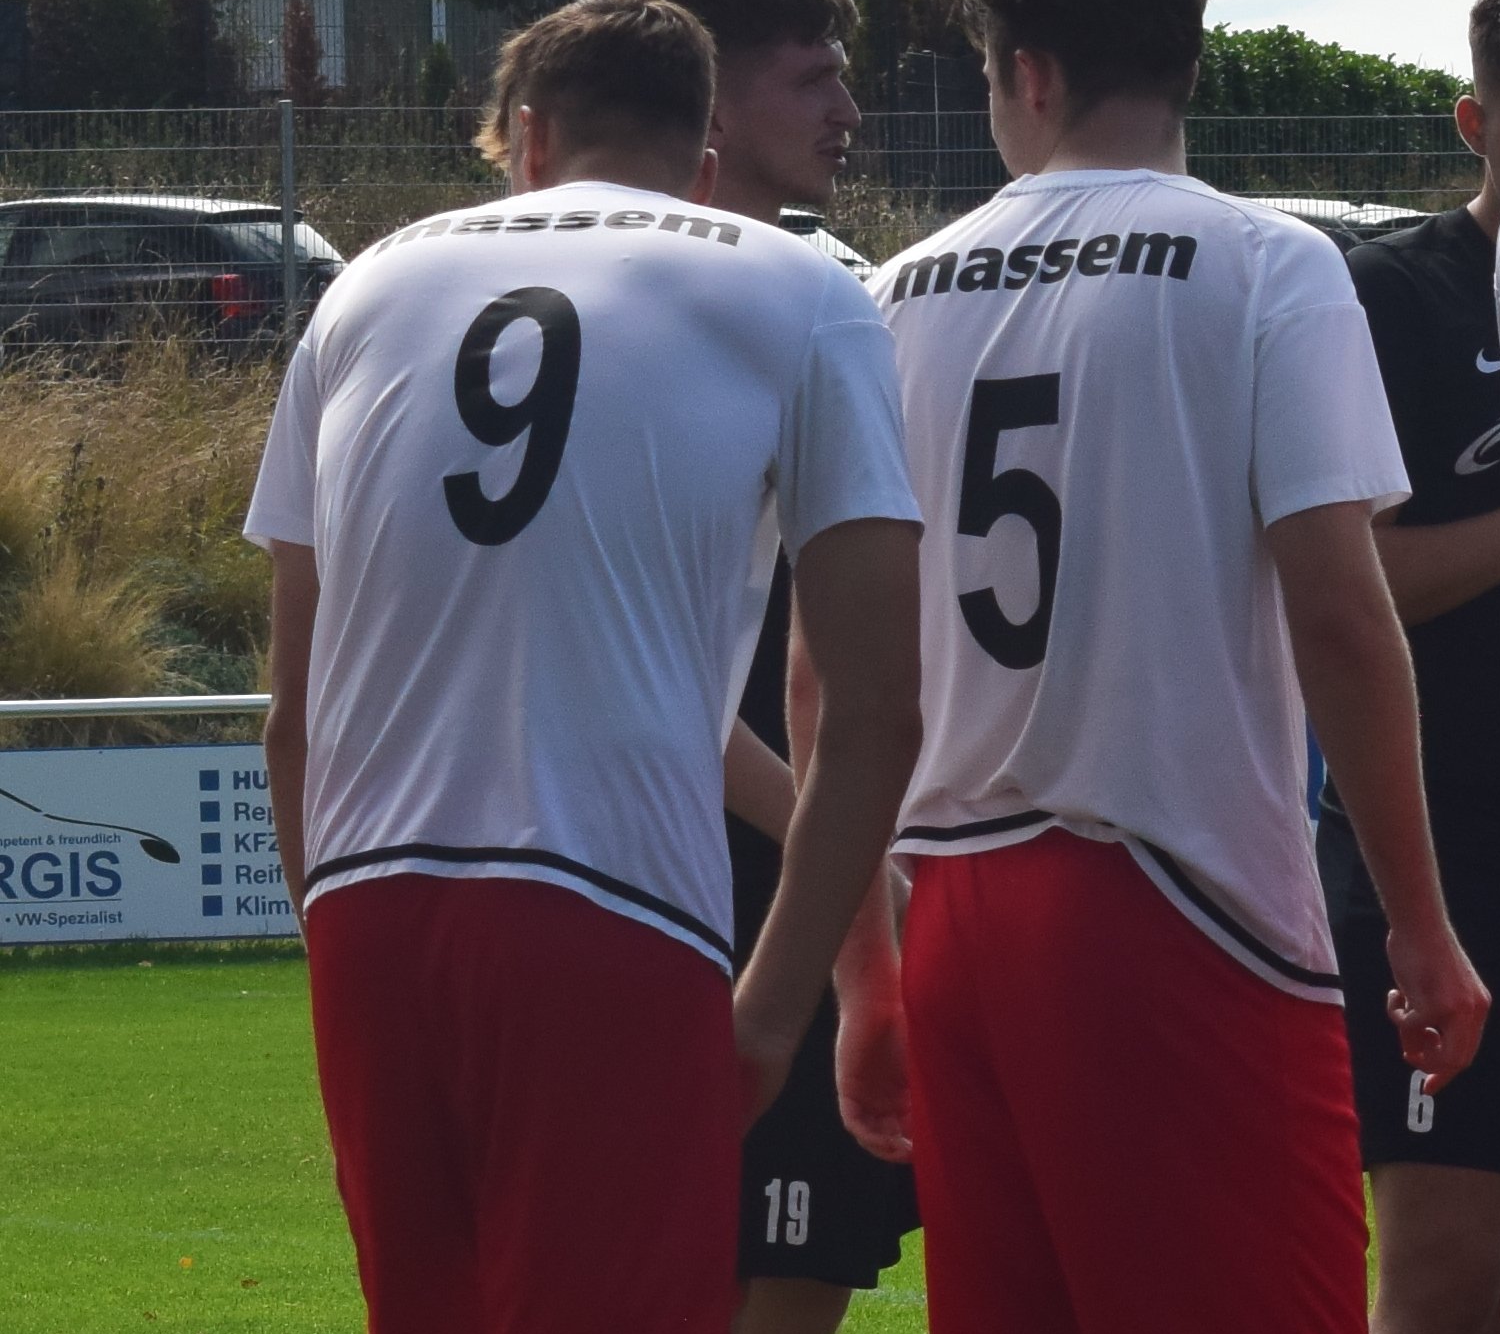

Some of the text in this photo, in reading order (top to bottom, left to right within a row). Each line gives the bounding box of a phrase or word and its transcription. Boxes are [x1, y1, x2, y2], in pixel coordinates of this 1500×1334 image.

[374, 210, 742, 259] massem
[891, 231, 1198, 303] massem
[443, 286, 581, 546] 9
[956, 372, 1063, 670] 5
[0, 832, 121, 849] petent & freundlich
[15, 911, 122, 929] VW-Spezialist
[236, 895, 294, 916] Klim
[765, 1177, 810, 1246] 19
